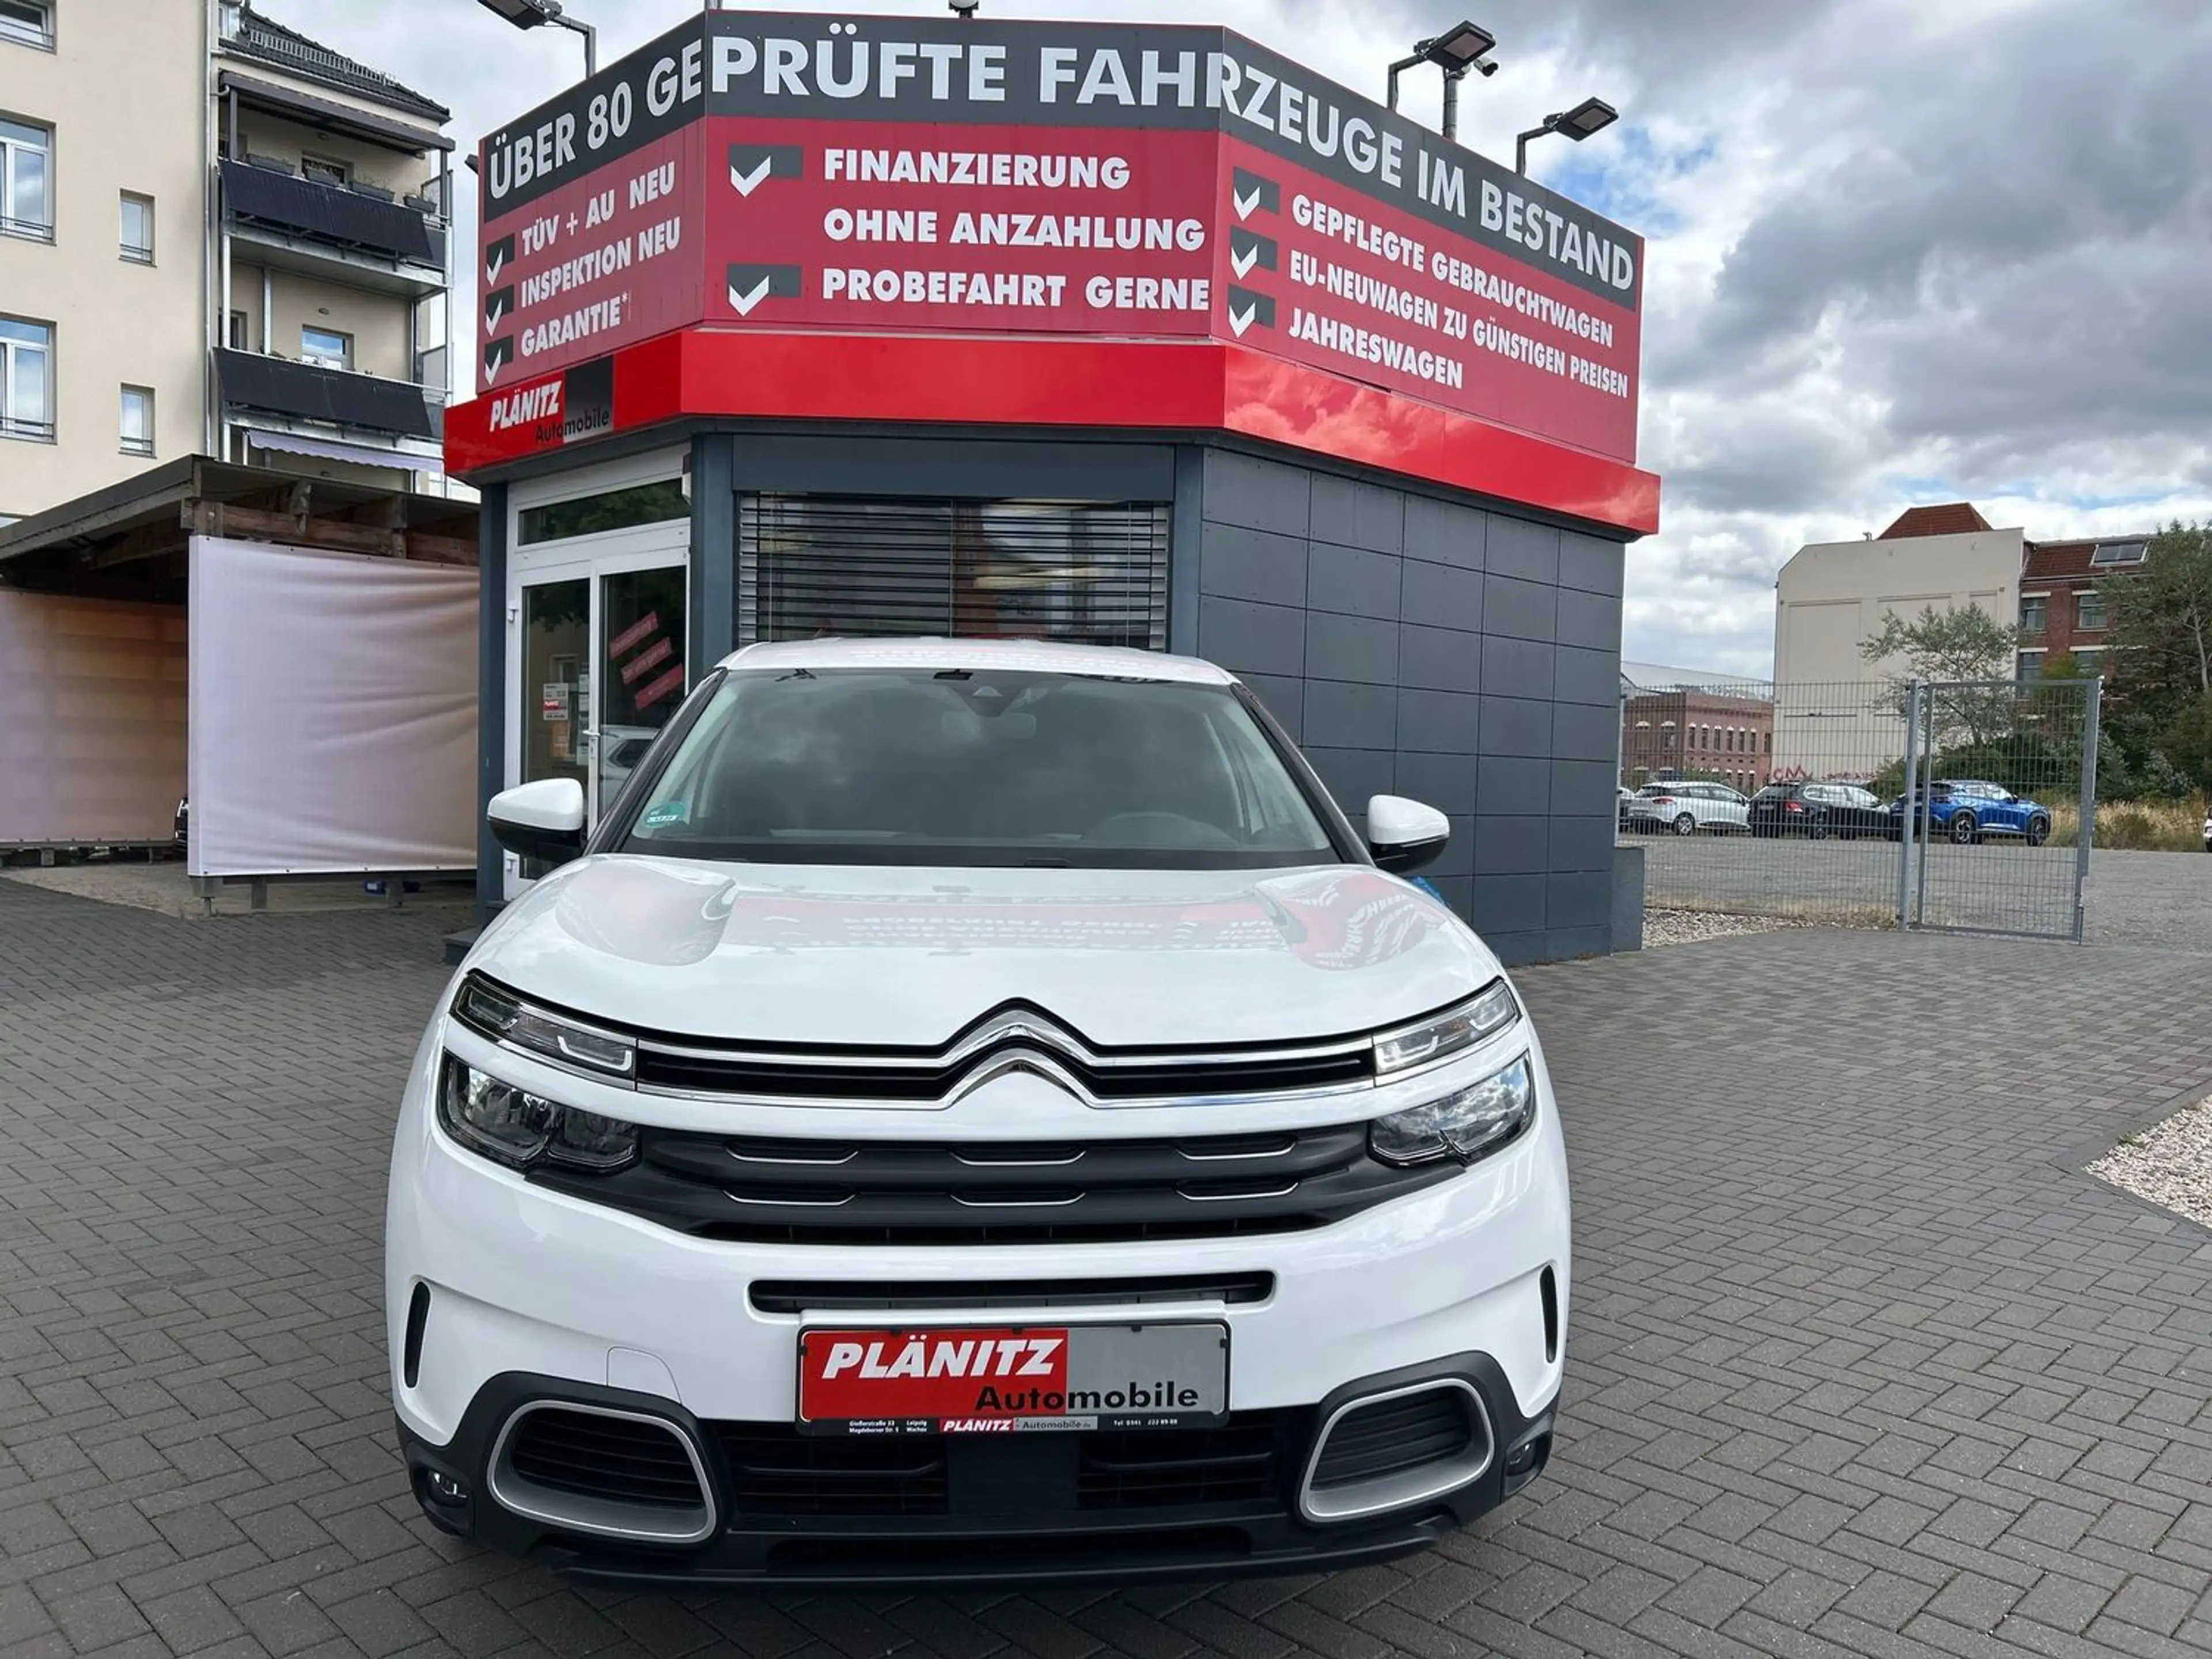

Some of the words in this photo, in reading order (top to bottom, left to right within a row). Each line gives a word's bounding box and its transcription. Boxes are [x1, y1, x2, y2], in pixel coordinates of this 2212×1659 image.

[490, 112, 575, 199] ÜBER
[587, 82, 632, 150] 80
[646, 22, 1006, 117] GEPRÜFTE
[1039, 47, 1402, 188] FAHRZEUGE
[1418, 150, 1465, 218] IM
[1481, 180, 1634, 290] BESTAND
[824, 149, 1130, 190] FINANZIERUNG
[522, 214, 559, 256] TÜV
[566, 211, 578, 236] +
[586, 190, 614, 229] AU
[630, 162, 675, 209] NEU
[824, 208, 937, 242] OHNE
[950, 213, 1205, 251] ANZAHLUNG
[521, 237, 631, 308] INSPEKTION
[638, 217, 680, 262] NEU
[1293, 195, 1424, 272] GEPFLEGTE
[1431, 252, 1612, 348] GEBRAUCHTWAGEN
[823, 268, 1066, 307] PROBEFAHRT
[1085, 277, 1209, 310] GERNE
[1290, 249, 1437, 329] EU-NEUWAGEN
[1444, 306, 1466, 339] ZU
[1474, 317, 1565, 376] GÜNSTIGEN
[1570, 357, 1628, 399] PREISEN
[1289, 307, 1462, 389] JAHRESWAGEN
[490, 381, 562, 432] PLÄNITZ
[536, 408, 609, 444] Automobile
[821, 1335, 1063, 1379] PLÄNITZ
[975, 1381, 1198, 1412] Automobile
[944, 1418, 1013, 1431] PLÄNITZ
